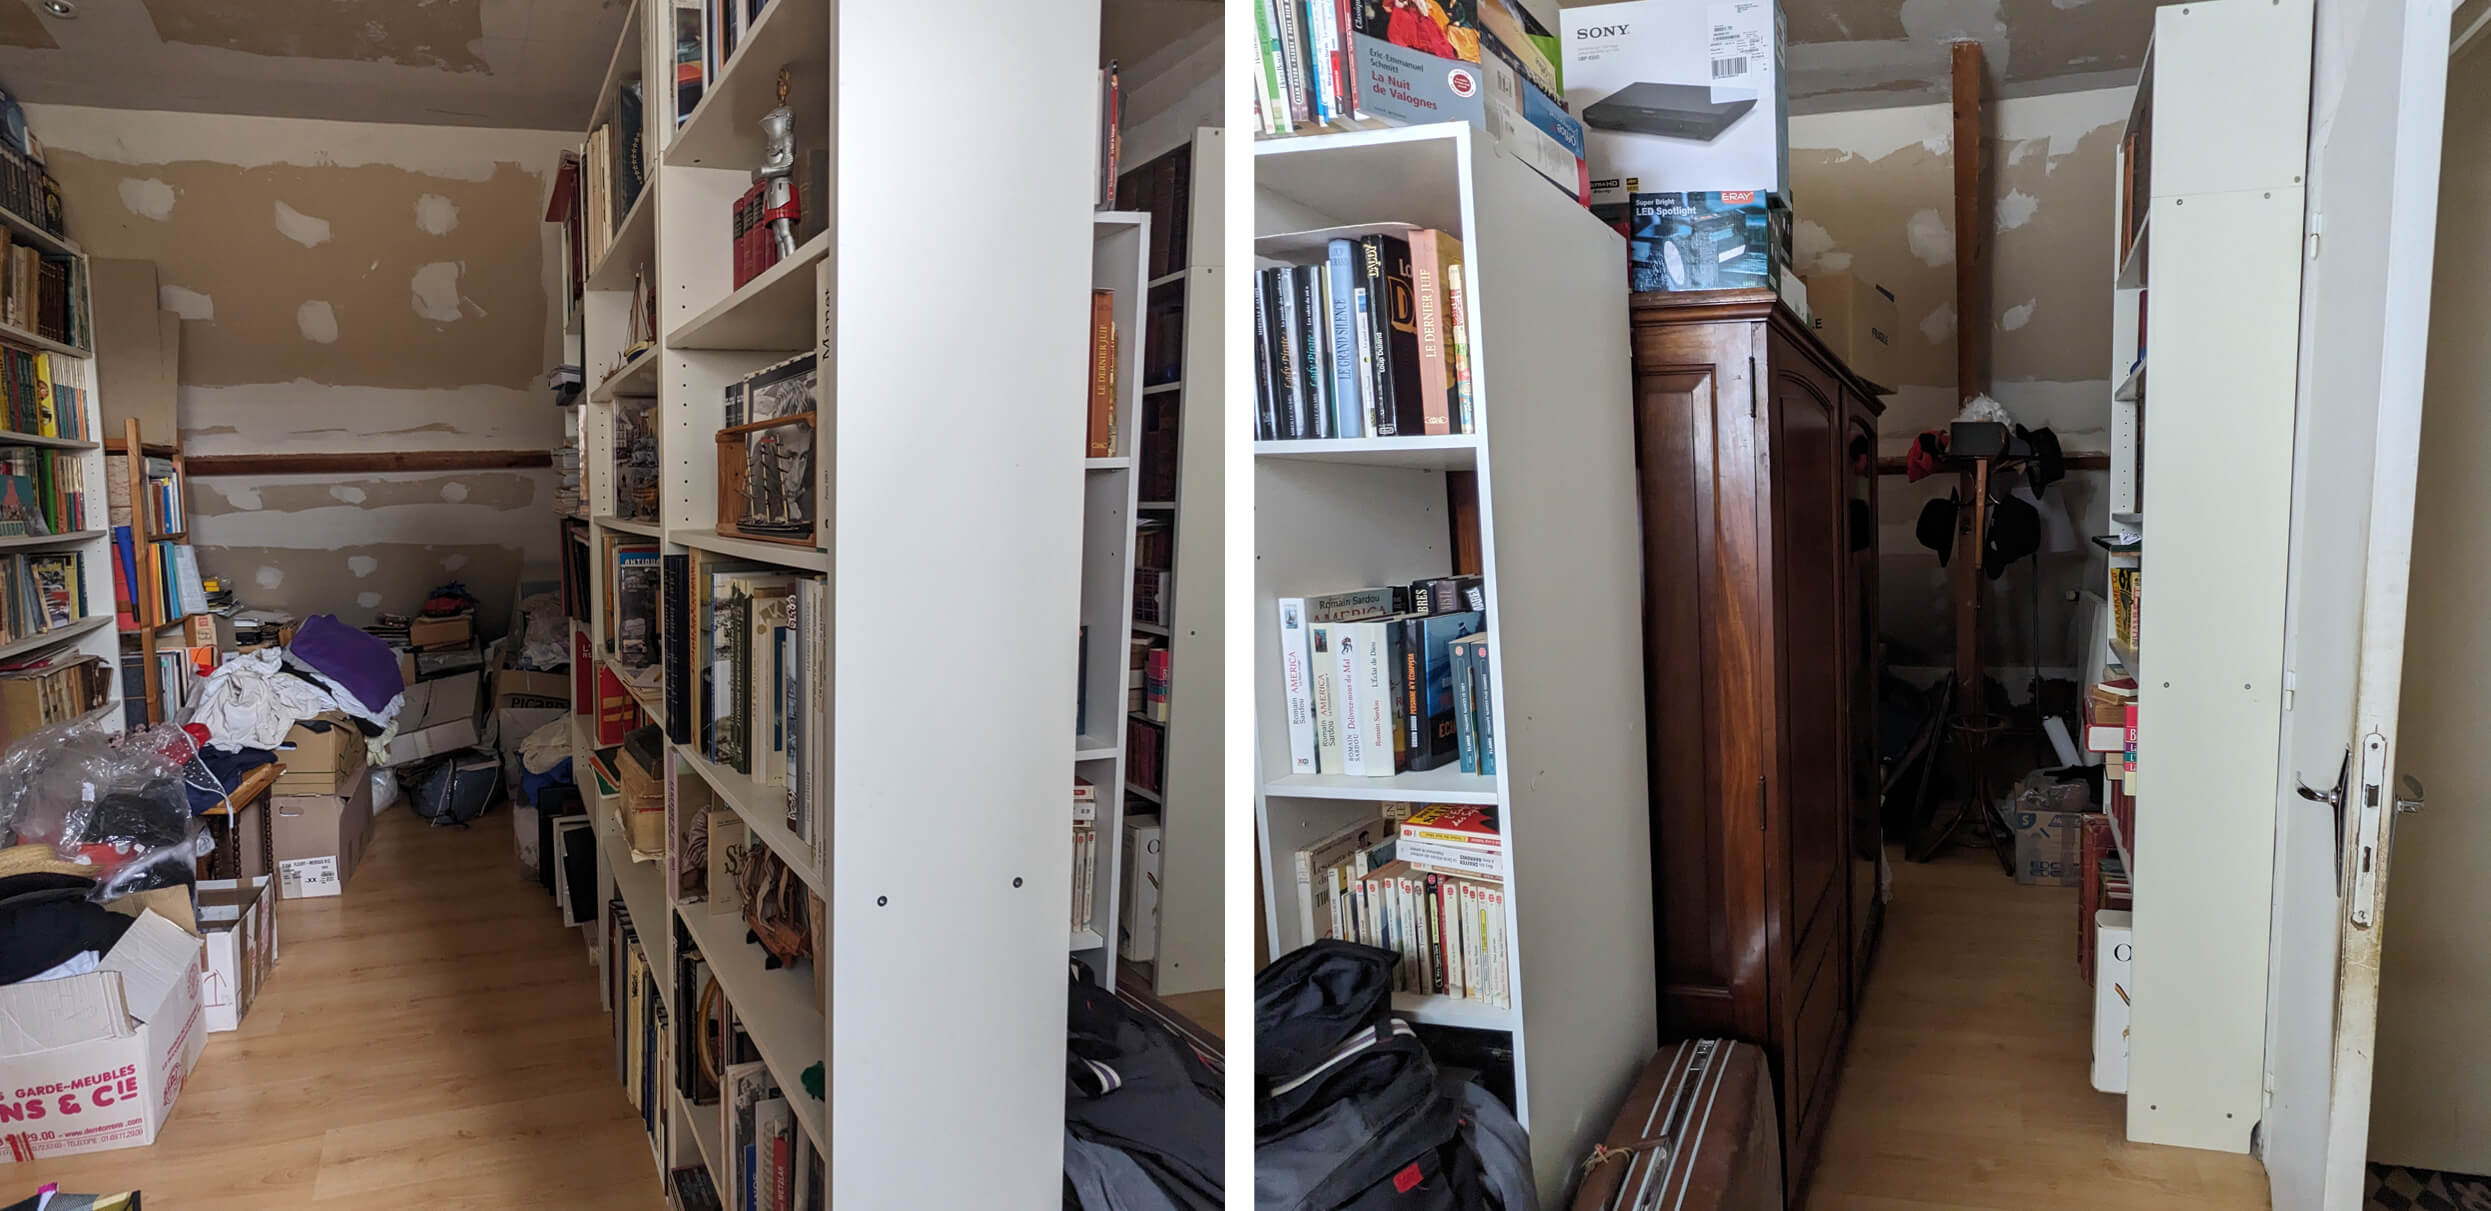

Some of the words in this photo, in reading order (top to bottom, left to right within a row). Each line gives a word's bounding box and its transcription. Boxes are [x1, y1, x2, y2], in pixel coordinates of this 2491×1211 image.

[1577, 24, 1629, 39] SONY
[1370, 58, 1399, 74] Schmitt
[1371, 71, 1385, 83] La
[1388, 74, 1411, 92] Nuit
[1372, 83, 1386, 96] de
[1390, 89, 1438, 111] Valognes
[1636, 199, 1654, 207] Super
[1656, 198, 1675, 206] Bright
[1636, 208, 1654, 216] LED
[1656, 207, 1696, 216] Spotlight
[1420, 269, 1433, 293] JUIF
[1333, 299, 1348, 335] SILENCE
[1422, 294, 1435, 342] DERNIER
[1337, 337, 1350, 367] GRAND
[1375, 332, 1384, 355] Durand
[1424, 345, 1437, 358] LE
[1098, 344, 1107, 382] DERNIER
[1377, 356, 1386, 373] Loup
[1338, 369, 1352, 381] LE
[1319, 599, 1351, 610] Romain
[1353, 594, 1380, 606] Sardou
[1288, 651, 1299, 693] AMERICA
[1343, 659, 1351, 672] Mal
[1372, 658, 1377, 667] de
[1318, 674, 1327, 716] AMERICA
[1291, 697, 1299, 725] Romain
[1320, 720, 1328, 747] Romain
[1327, 721, 1335, 746] Sardou
[15, 1064, 136, 1098] GARDE-MEUBLES
[58, 1094, 82, 1115] &
